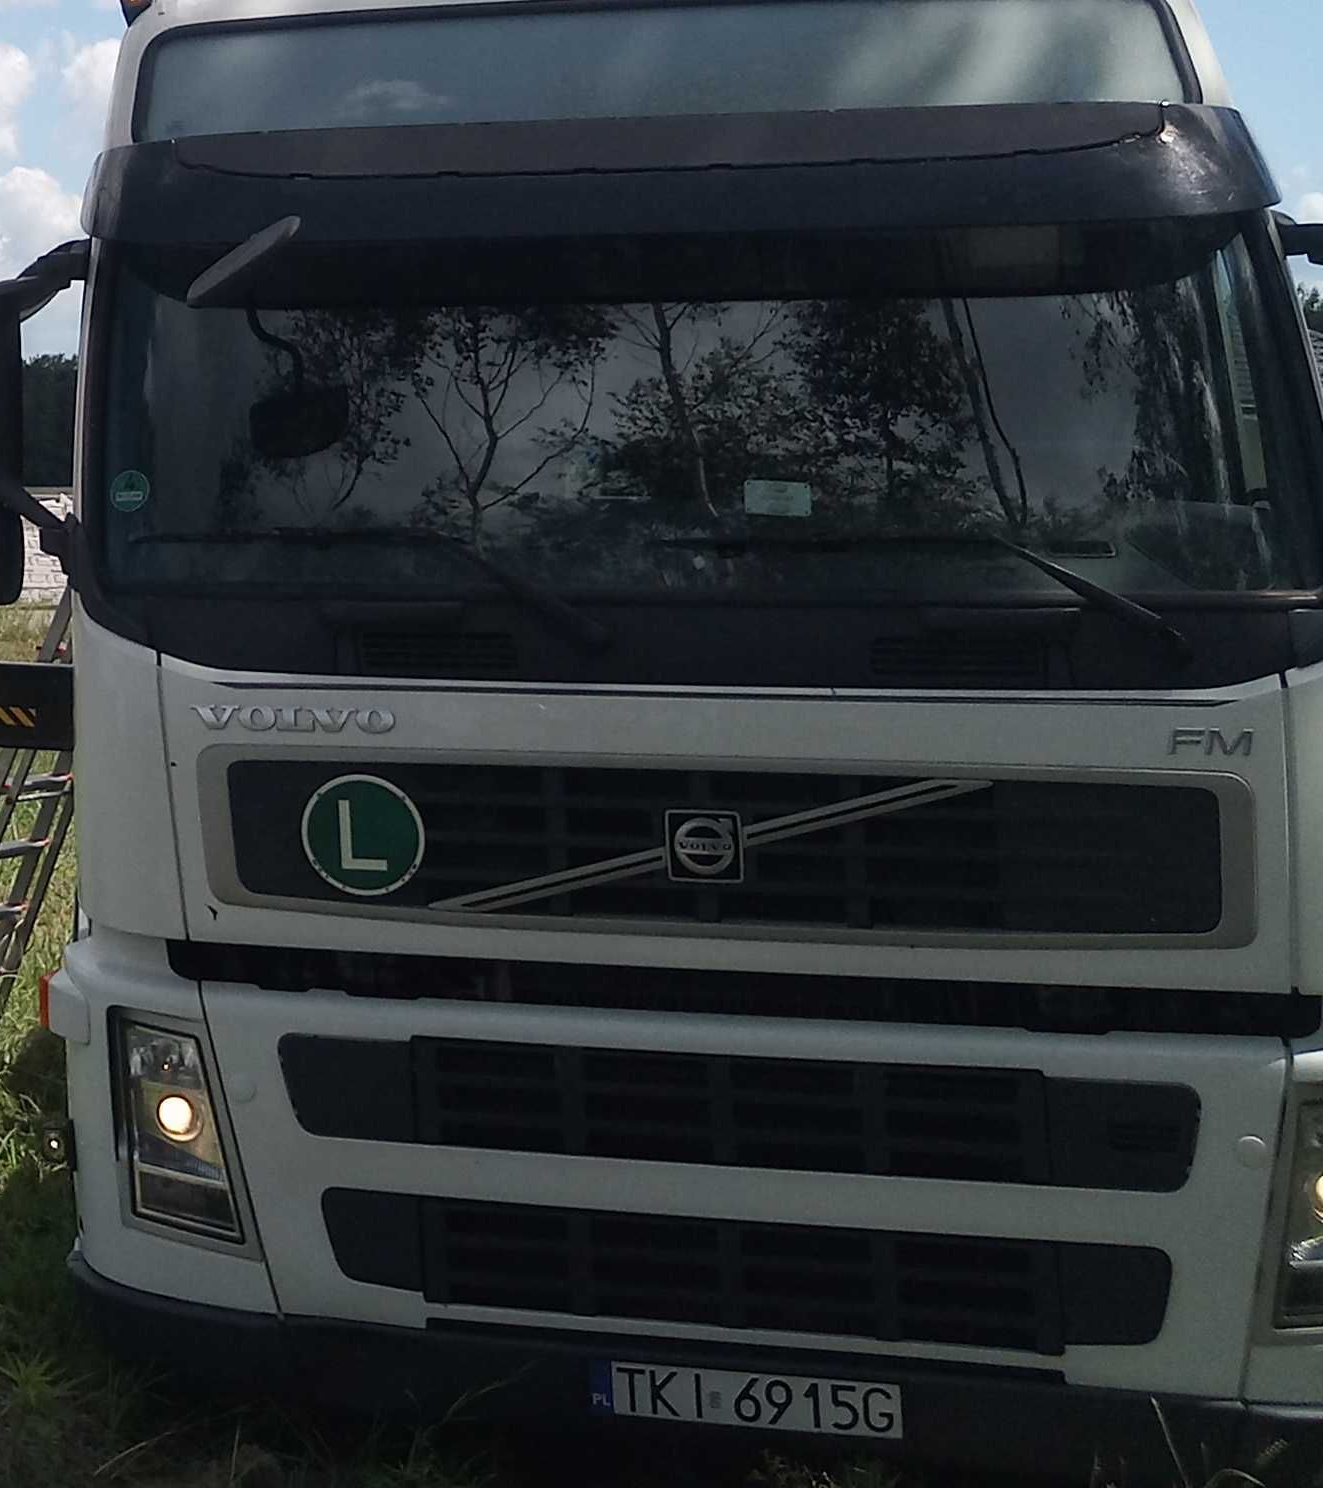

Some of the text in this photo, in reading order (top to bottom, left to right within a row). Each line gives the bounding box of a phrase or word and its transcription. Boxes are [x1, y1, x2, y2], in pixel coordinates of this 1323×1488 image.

[189, 704, 396, 734] VOLVO
[1167, 727, 1254, 756] FM
[337, 799, 388, 871] L
[592, 1393, 612, 1407] PL
[616, 1366, 895, 1433] TKI 6915G
